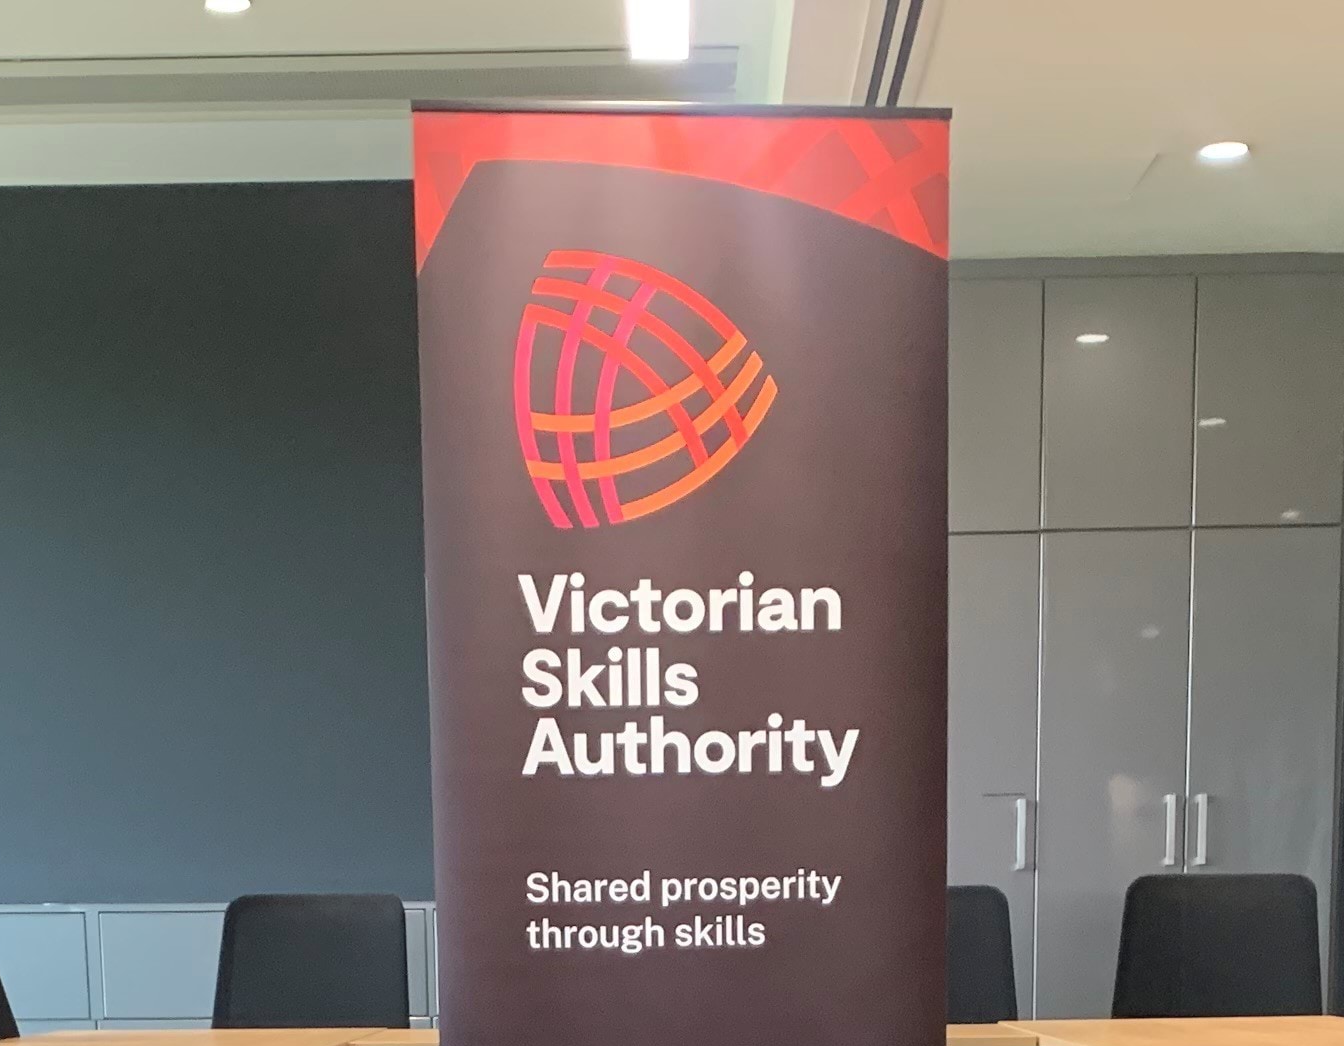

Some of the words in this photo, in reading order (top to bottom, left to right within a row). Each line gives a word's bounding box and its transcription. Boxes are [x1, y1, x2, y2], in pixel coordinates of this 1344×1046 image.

[518, 571, 841, 633] Victorian
[522, 647, 698, 707] Skills
[522, 713, 859, 787] Authority
[527, 871, 650, 903] Shared
[662, 869, 841, 907] prosperity
[526, 917, 664, 954] through
[675, 915, 765, 947] skills
